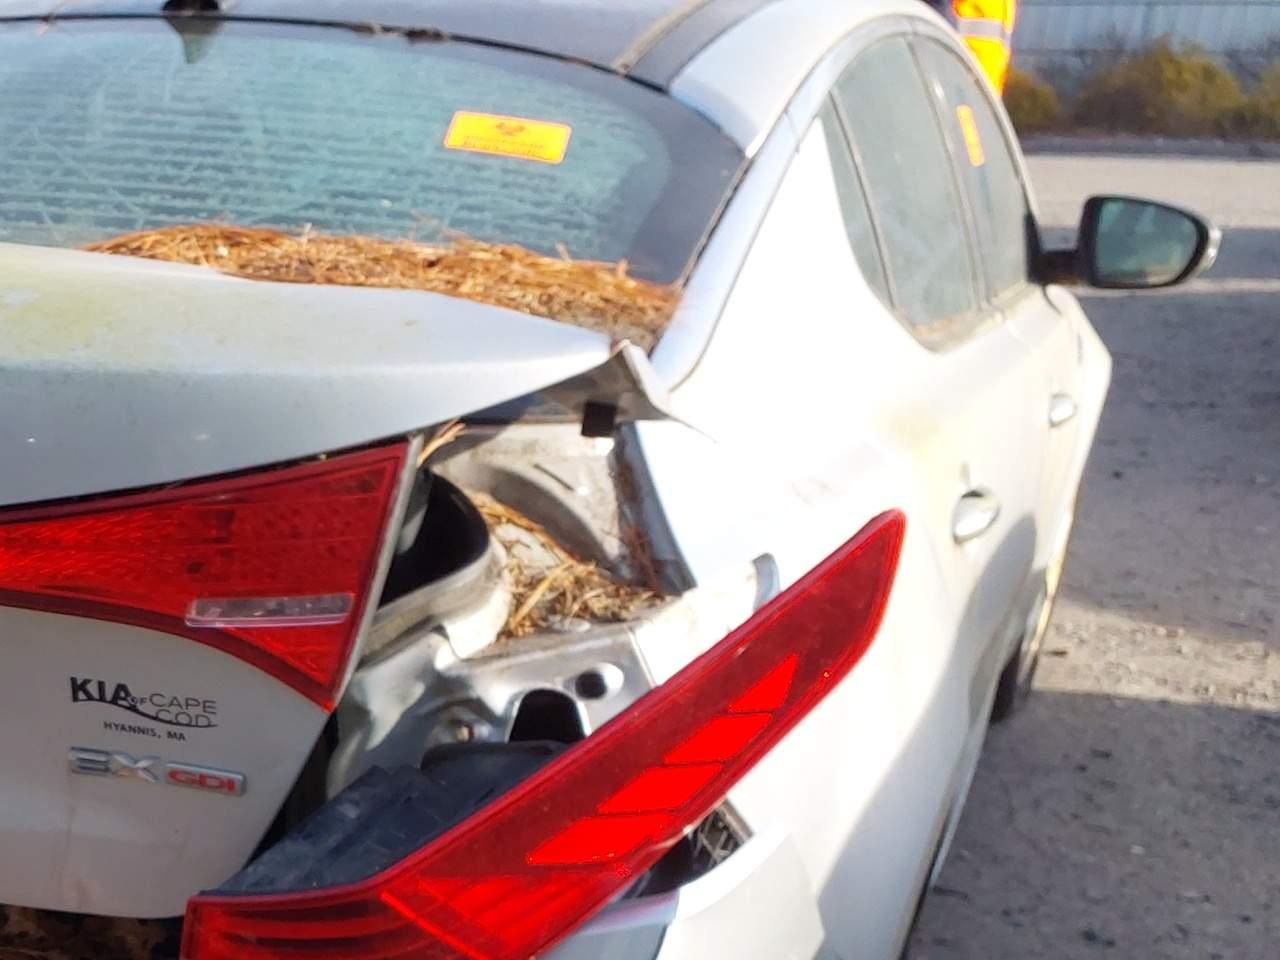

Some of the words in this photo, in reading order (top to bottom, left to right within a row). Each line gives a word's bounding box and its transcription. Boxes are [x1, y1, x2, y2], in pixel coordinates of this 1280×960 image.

[69, 676, 133, 706] KIA
[149, 692, 218, 715] CAPE
[103, 720, 162, 739] HYANNIS,
[166, 730, 187, 742] MA
[155, 709, 212, 728] COD
[69, 746, 161, 784] EX
[167, 768, 236, 793] GDI
